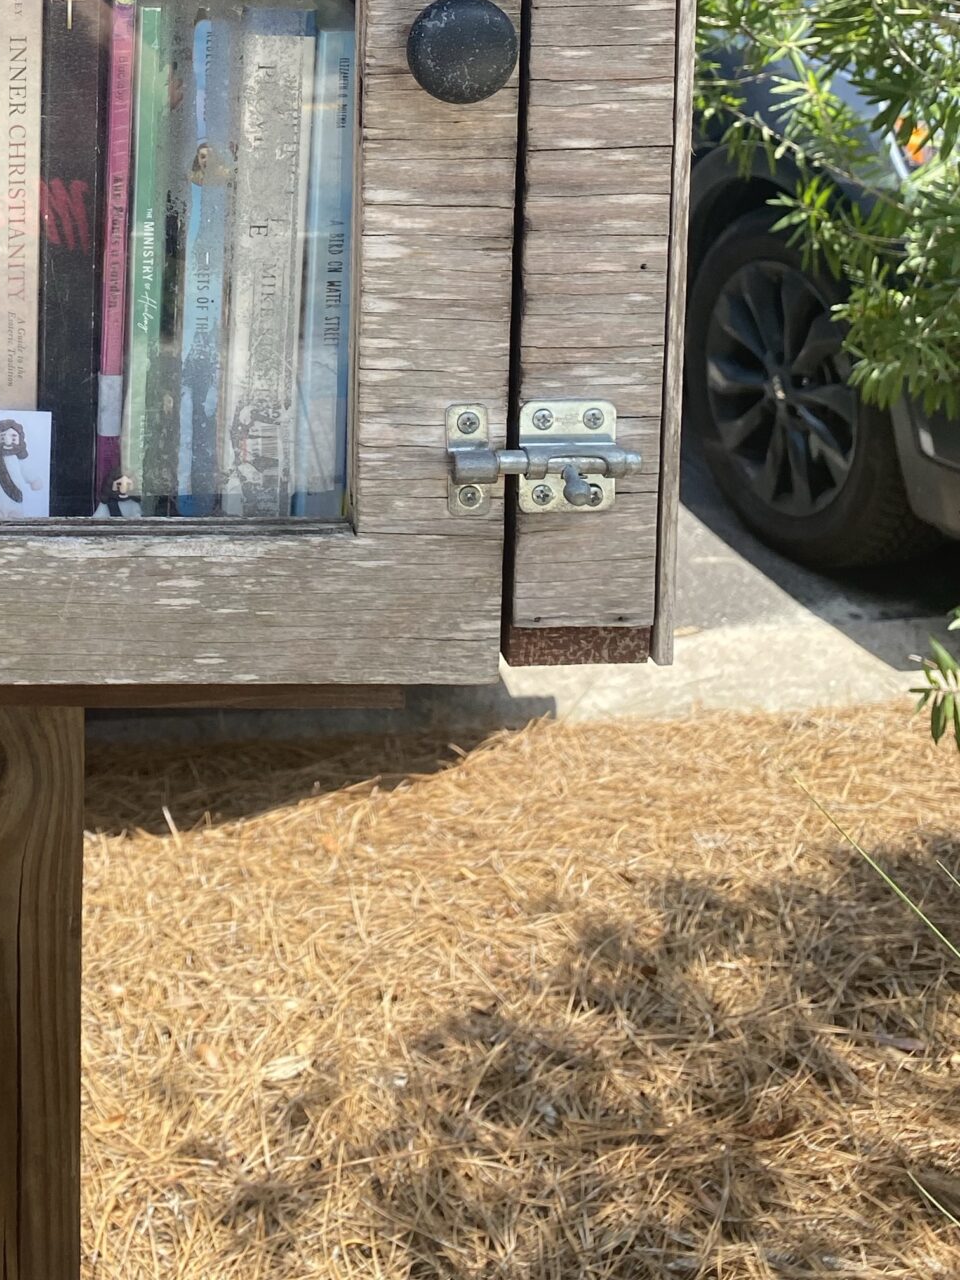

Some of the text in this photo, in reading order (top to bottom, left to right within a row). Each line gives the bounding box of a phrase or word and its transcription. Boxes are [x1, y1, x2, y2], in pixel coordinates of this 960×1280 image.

[8, 36, 28, 116] INNER
[7, 124, 27, 301] CHRISTIANITY
[145, 208, 153, 219] THE
[142, 221, 155, 281] MINISTRY
[328, 233, 345, 255] BIRD
[327, 261, 343, 273] ON
[196, 297, 209, 311] OF
[326, 280, 342, 309] WATER
[17, 327, 26, 353] Guide
[323, 316, 340, 347] STREET
[7, 348, 17, 387] Tradition
[17, 355, 24, 363] to
[17, 366, 26, 379] the
